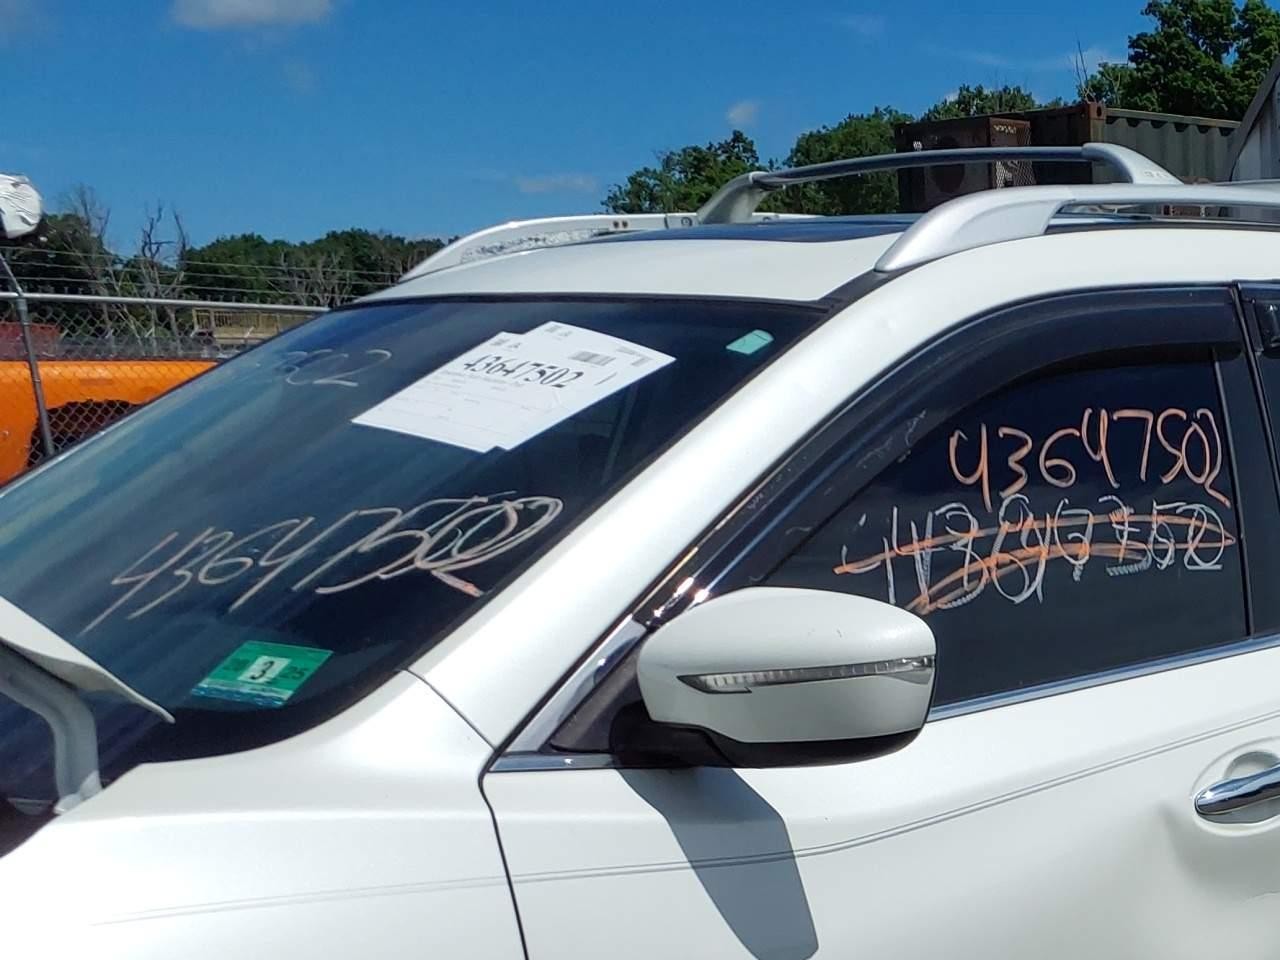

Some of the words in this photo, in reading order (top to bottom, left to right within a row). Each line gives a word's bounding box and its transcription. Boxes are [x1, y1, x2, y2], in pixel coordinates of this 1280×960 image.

[464, 353, 585, 388] 43647502
[948, 407, 1232, 513] 43647502
[250, 660, 275, 680] 3
